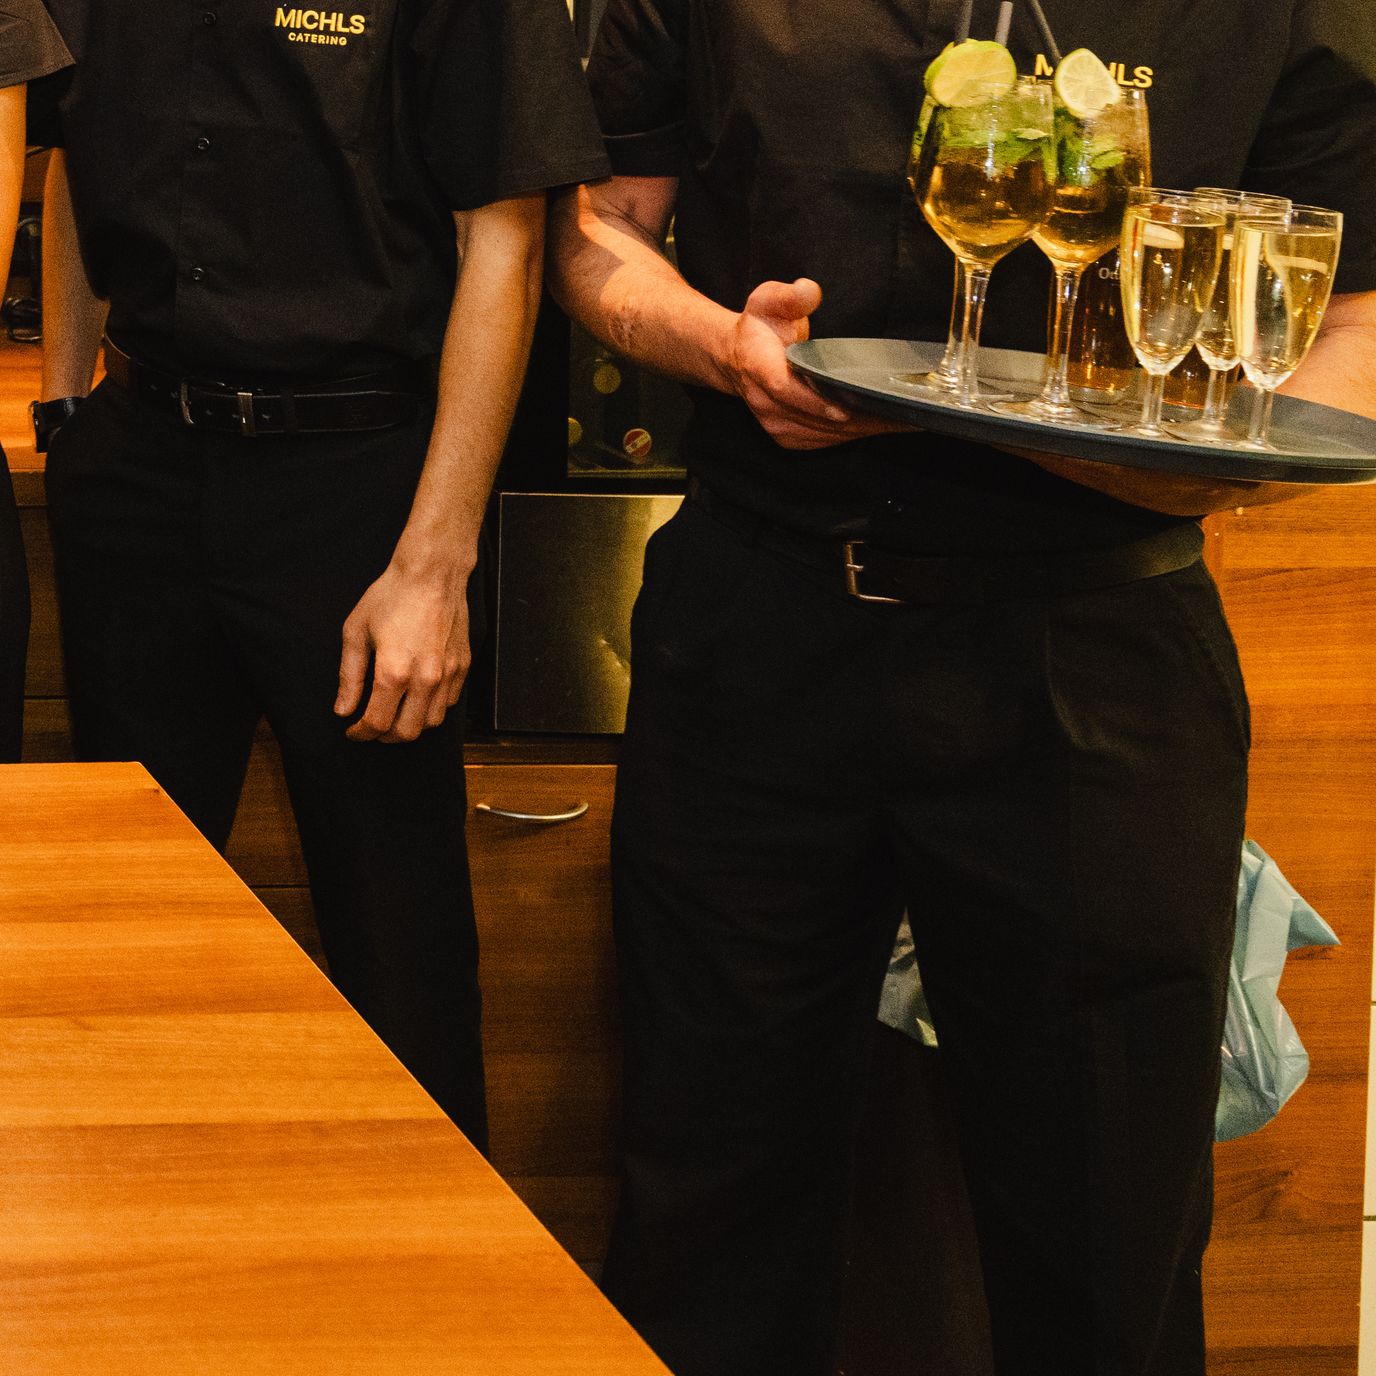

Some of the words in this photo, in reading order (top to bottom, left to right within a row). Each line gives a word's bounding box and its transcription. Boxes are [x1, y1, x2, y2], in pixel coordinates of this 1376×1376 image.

[274, 7, 366, 35] MICHLS
[288, 32, 348, 46] CATERING
[1034, 53, 1154, 89] MLS
